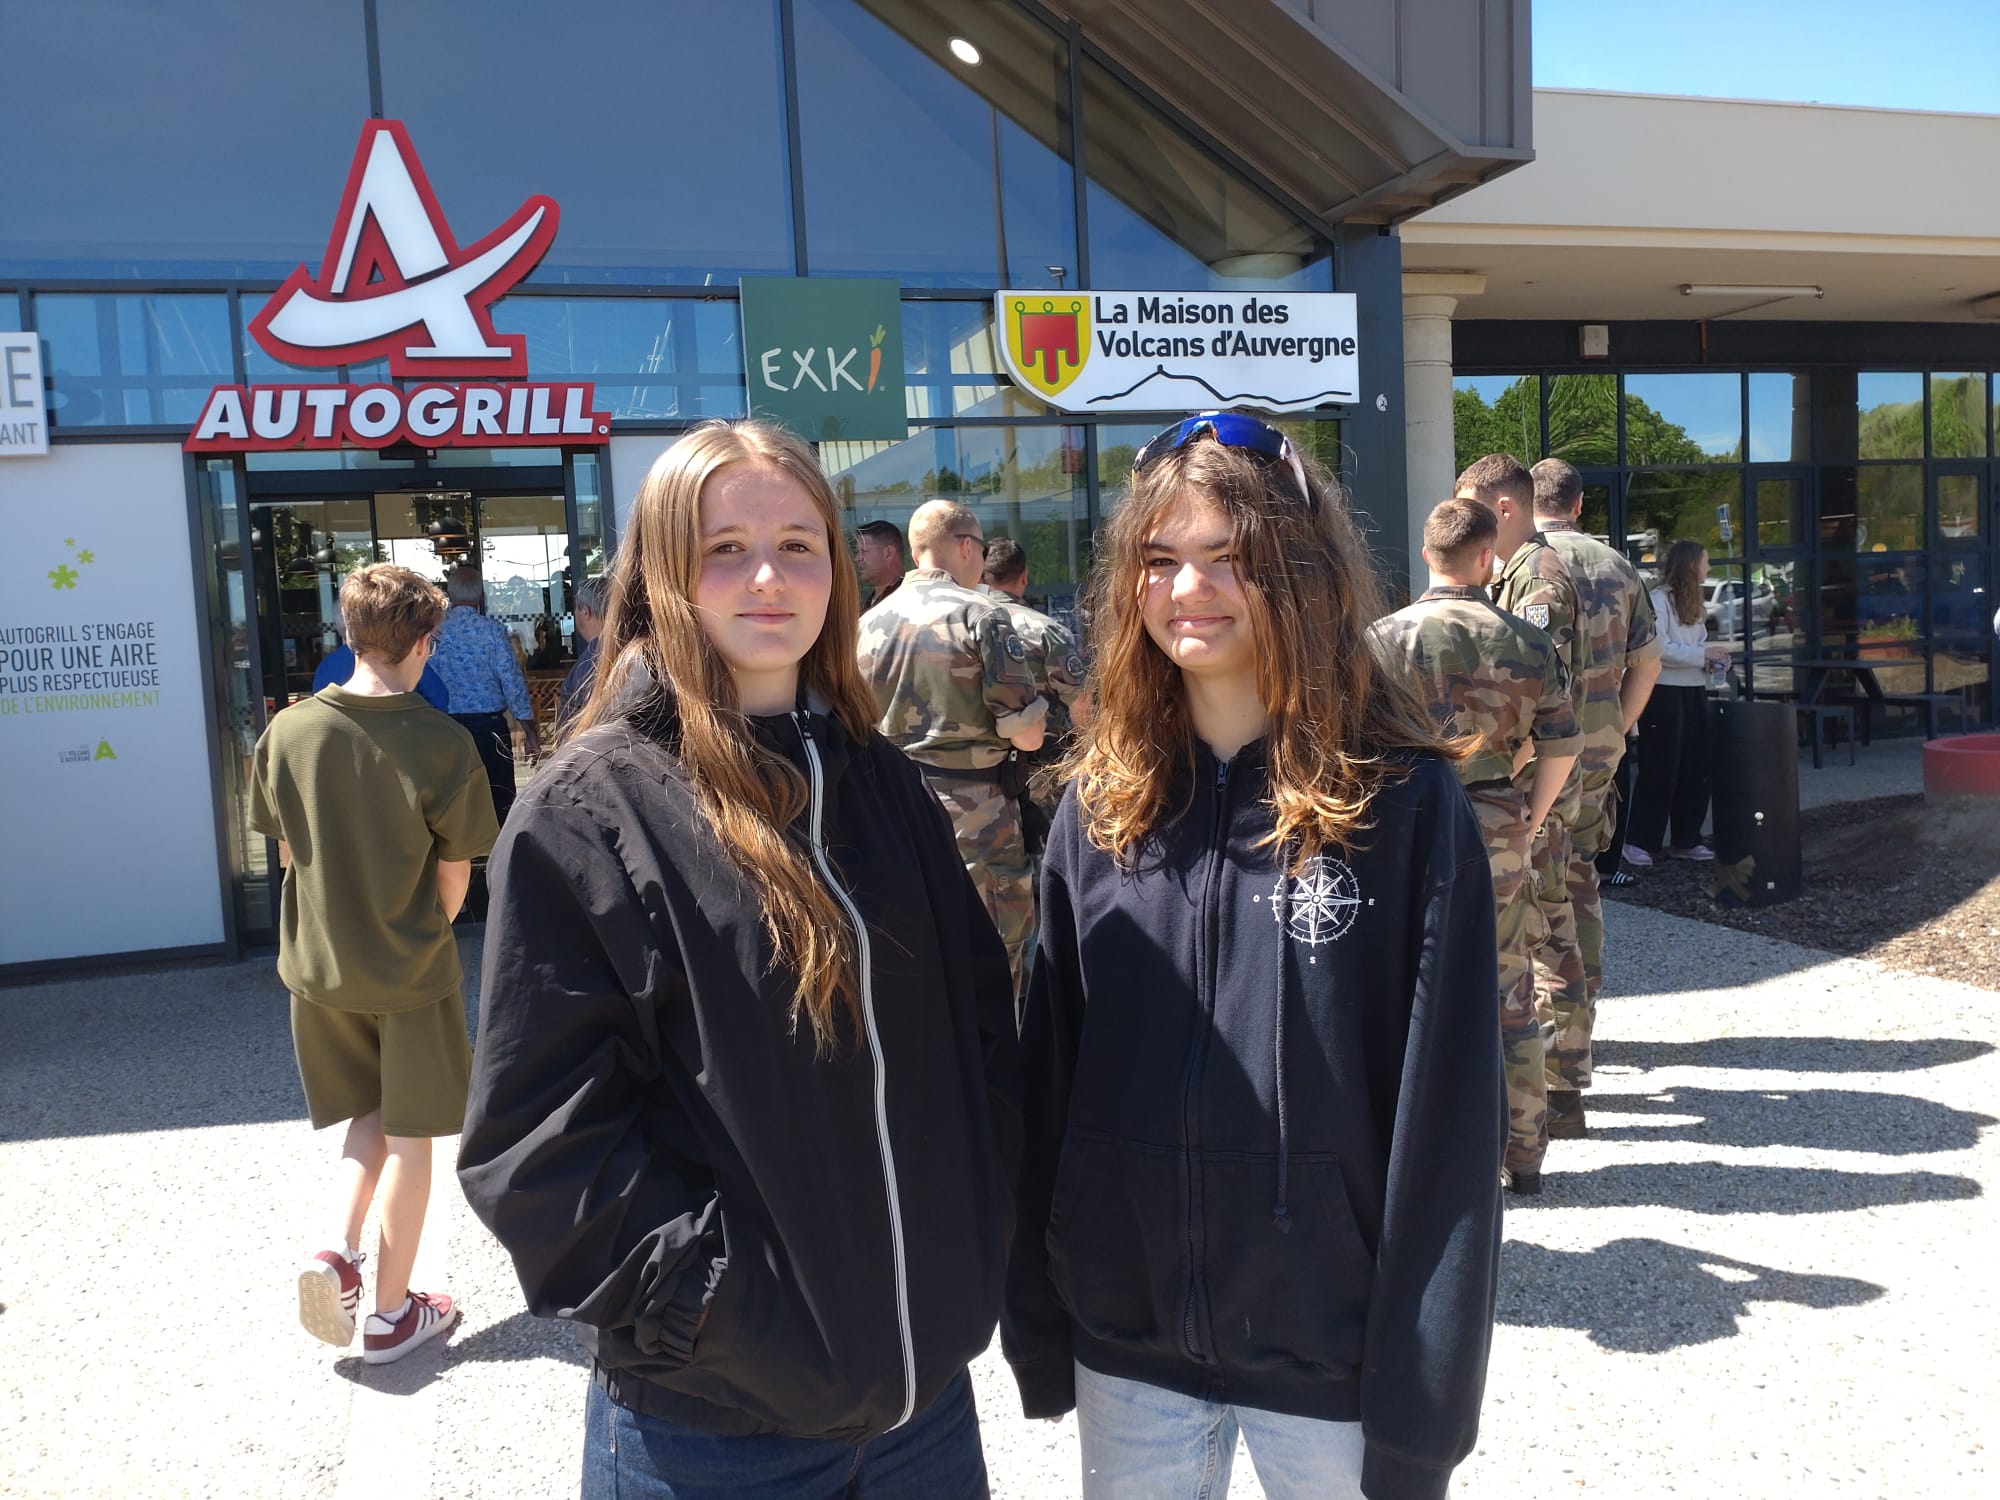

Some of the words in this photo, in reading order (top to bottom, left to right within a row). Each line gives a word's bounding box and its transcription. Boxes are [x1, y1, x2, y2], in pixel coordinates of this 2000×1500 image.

[1095, 296, 1128, 324] La
[1137, 296, 1234, 324] Maison
[1242, 297, 1289, 324] des
[1097, 330, 1205, 357] Volcans
[195, 386, 594, 440] AUTOGRILL
[0, 626, 78, 645] AUTOGRILL
[81, 622, 156, 641] S'ENGAGE
[0, 647, 54, 673] POUR
[61, 645, 104, 669] UNE
[110, 643, 157, 667] AIRE
[0, 675, 38, 694] PLUS
[43, 669, 160, 692] RESPECTUEUSE
[1, 697, 20, 715] DE
[24, 689, 160, 714] L'ENVIRONNEMENT
